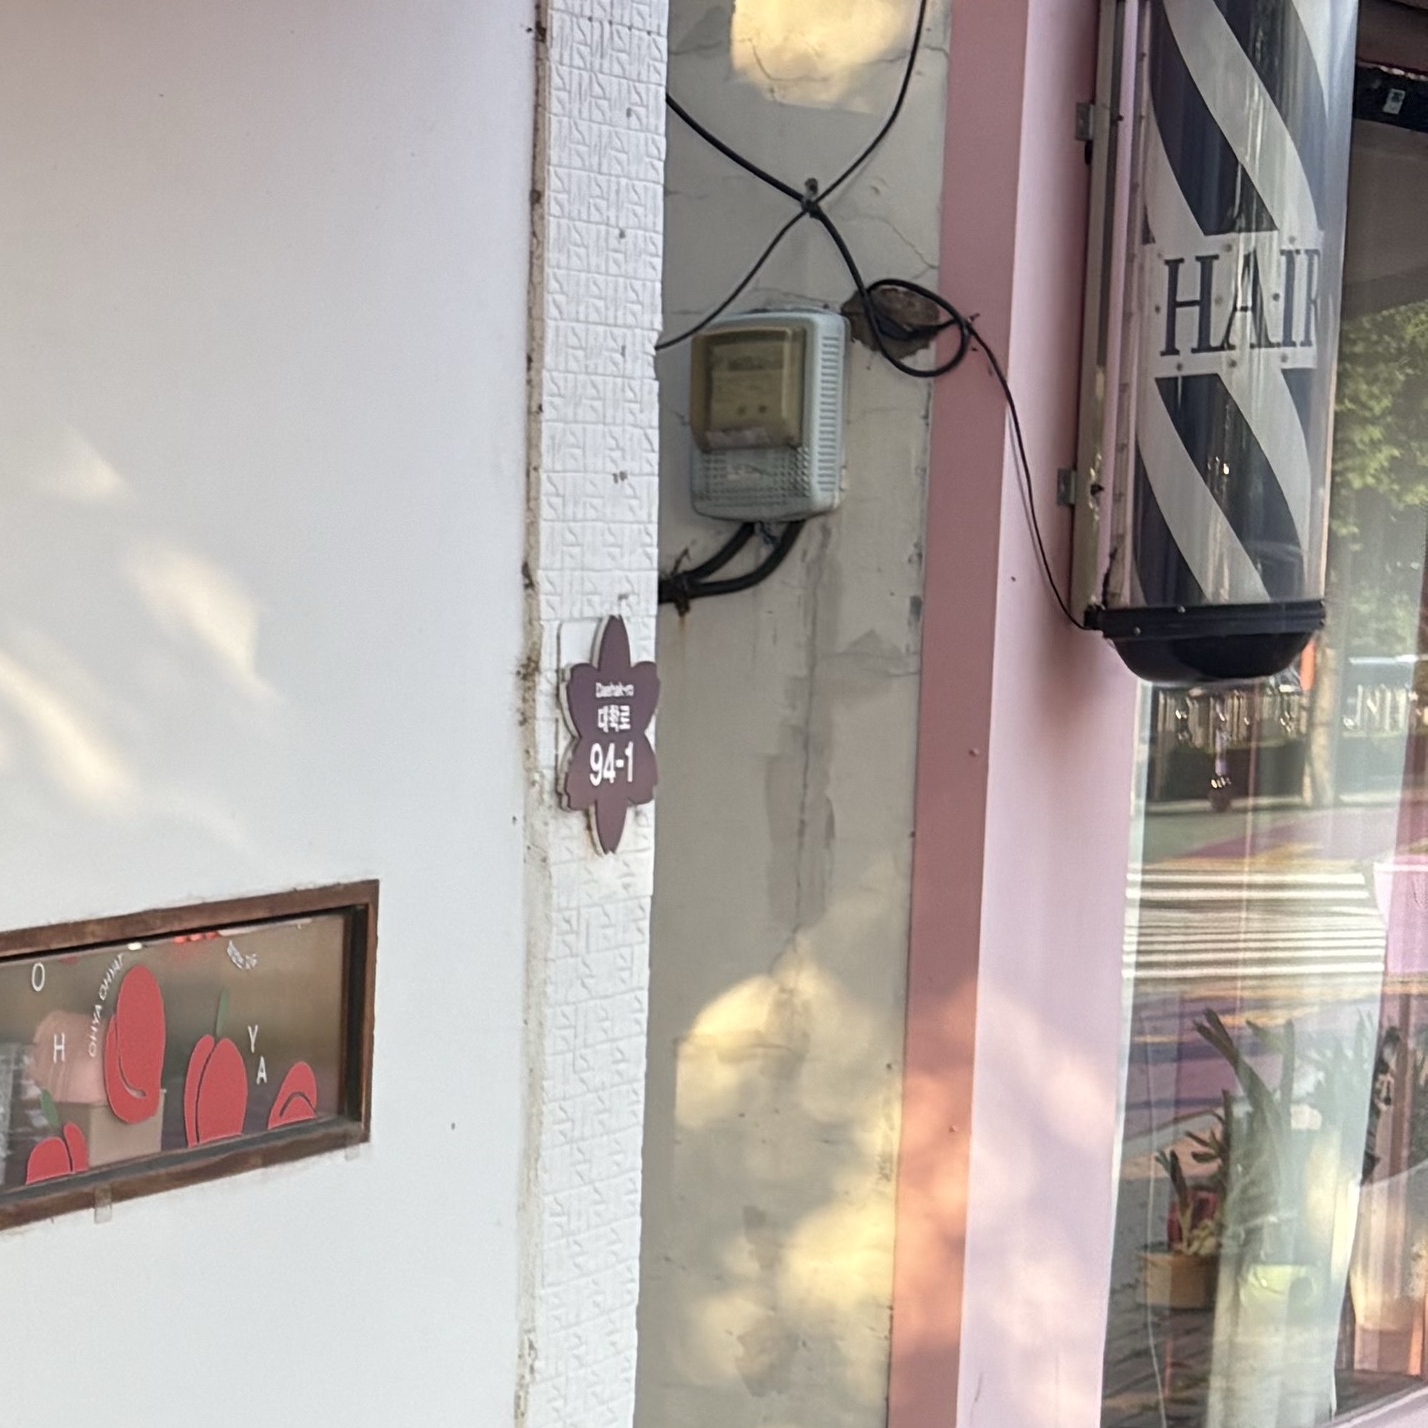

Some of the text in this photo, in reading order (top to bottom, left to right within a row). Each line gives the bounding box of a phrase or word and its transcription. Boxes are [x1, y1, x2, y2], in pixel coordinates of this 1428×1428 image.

[597, 704, 631, 732] 대학로
[589, 741, 634, 786] 94-1
[53, 1032, 65, 1063] H
[248, 1024, 258, 1053] Y
[256, 1056, 267, 1085] A
